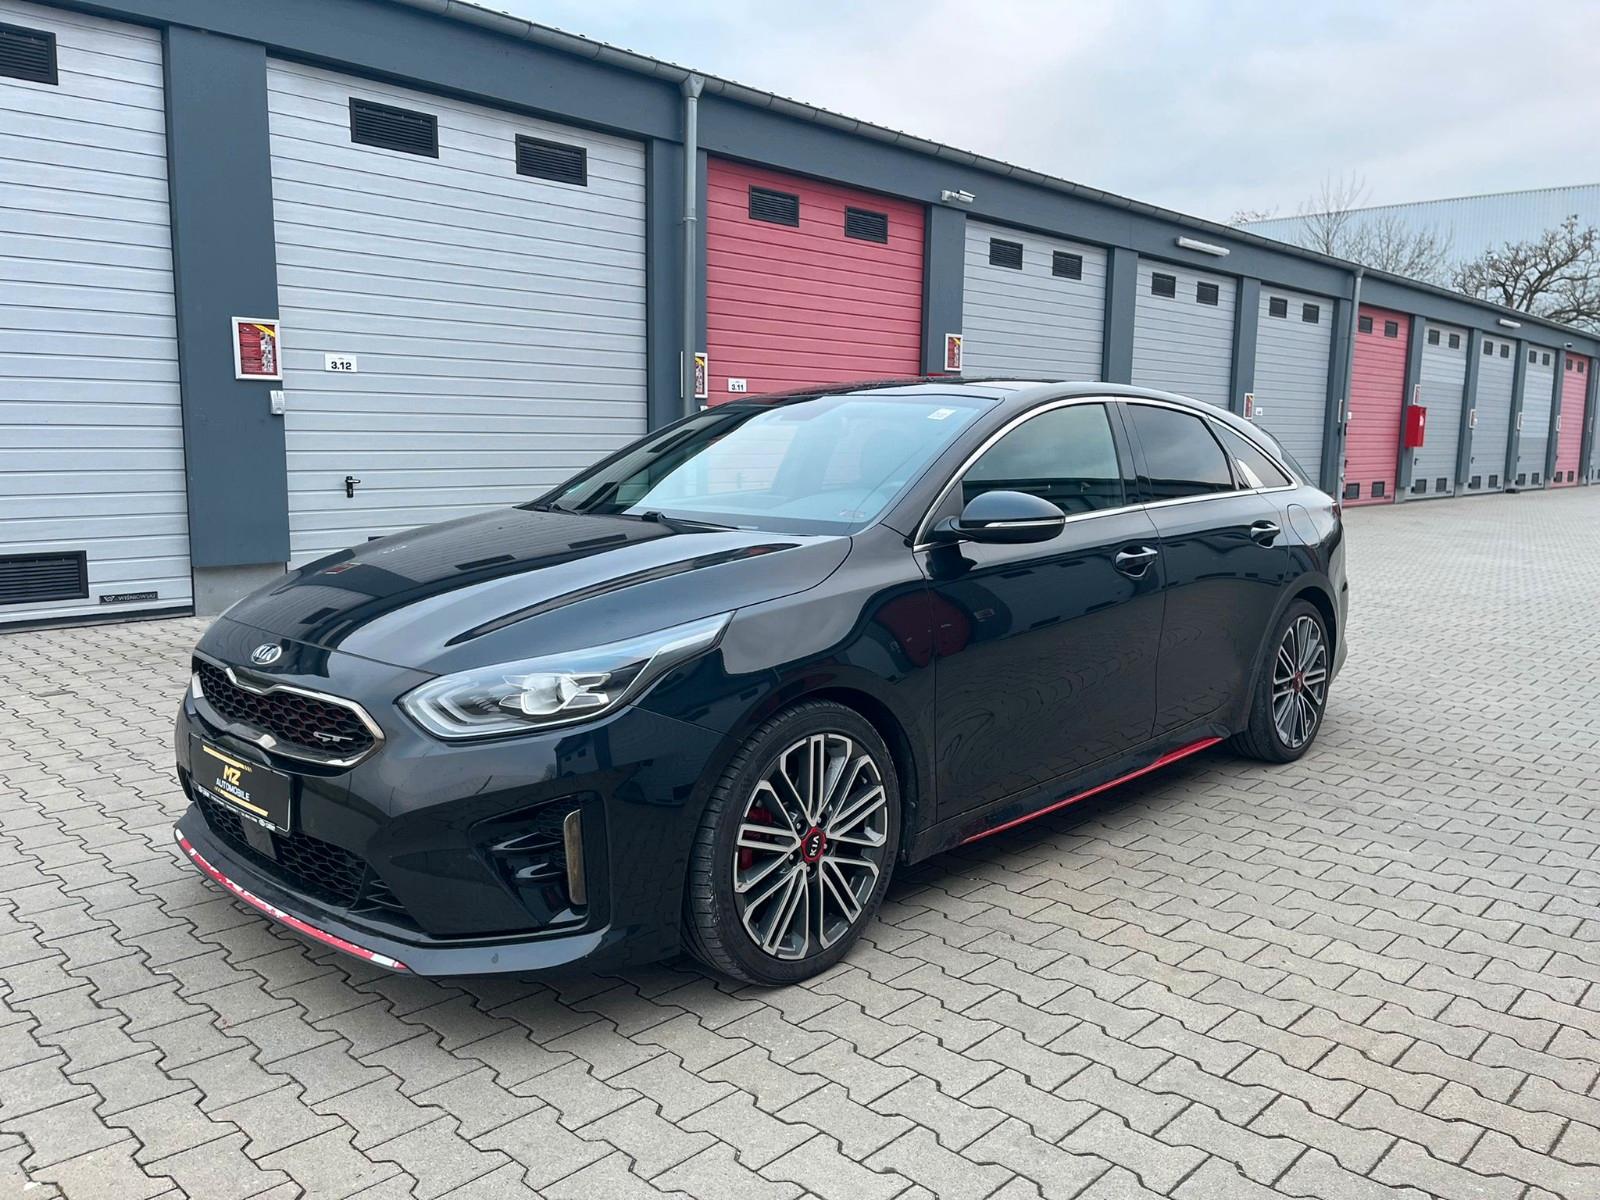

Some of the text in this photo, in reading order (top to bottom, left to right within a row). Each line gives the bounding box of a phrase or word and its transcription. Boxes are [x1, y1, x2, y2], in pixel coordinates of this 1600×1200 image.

[331, 361, 352, 370] 3.12
[253, 644, 278, 661] KIA
[223, 765, 241, 786] MZ
[216, 778, 250, 801] AUTOMOBILE
[810, 835, 820, 856] KIA
